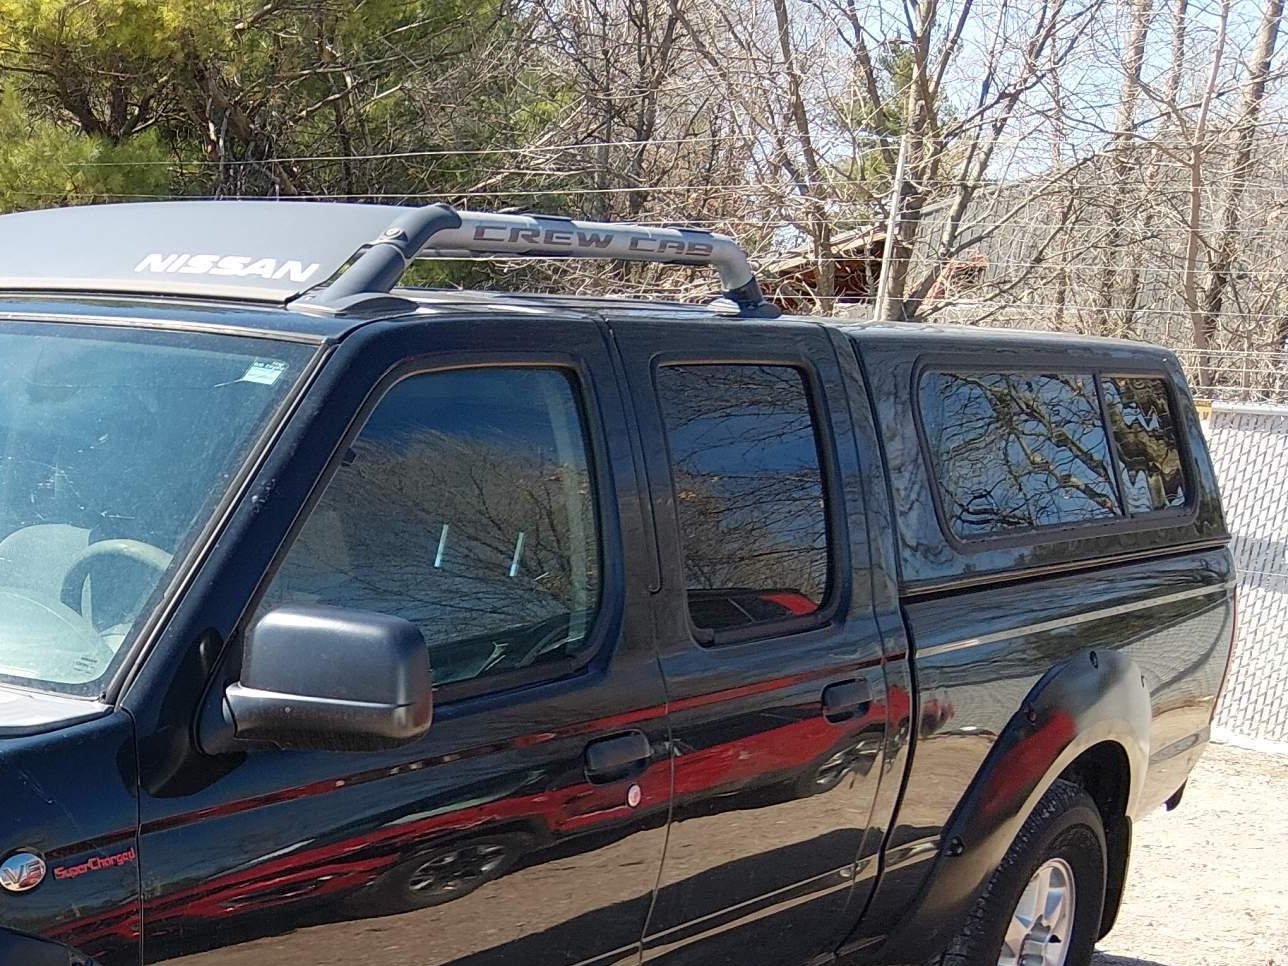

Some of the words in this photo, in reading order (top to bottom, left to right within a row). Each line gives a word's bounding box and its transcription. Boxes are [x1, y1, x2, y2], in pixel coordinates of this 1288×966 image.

[473, 225, 612, 249] CREW
[629, 236, 714, 257] CAB
[134, 253, 320, 282] NISSAN
